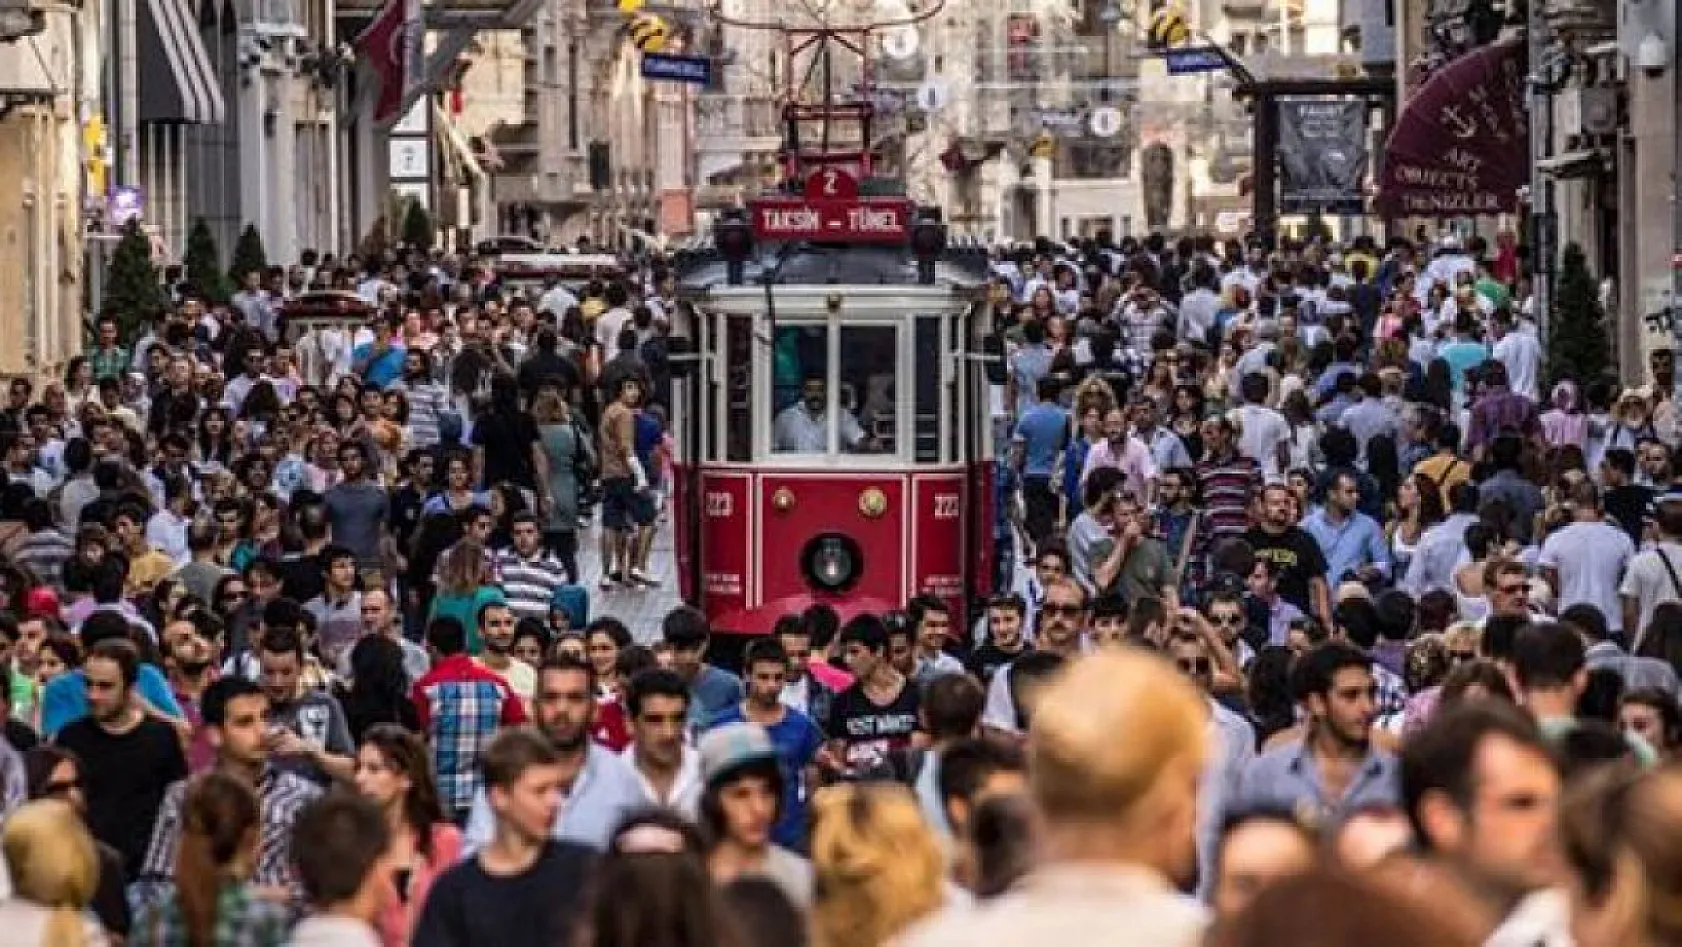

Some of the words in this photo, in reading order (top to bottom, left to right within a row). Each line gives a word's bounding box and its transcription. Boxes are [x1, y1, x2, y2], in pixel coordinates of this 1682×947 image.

[823, 171, 839, 195] 2
[1395, 165, 1480, 190] OBJECTS
[847, 206, 903, 232] TÜNEL
[705, 492, 734, 517] 223
